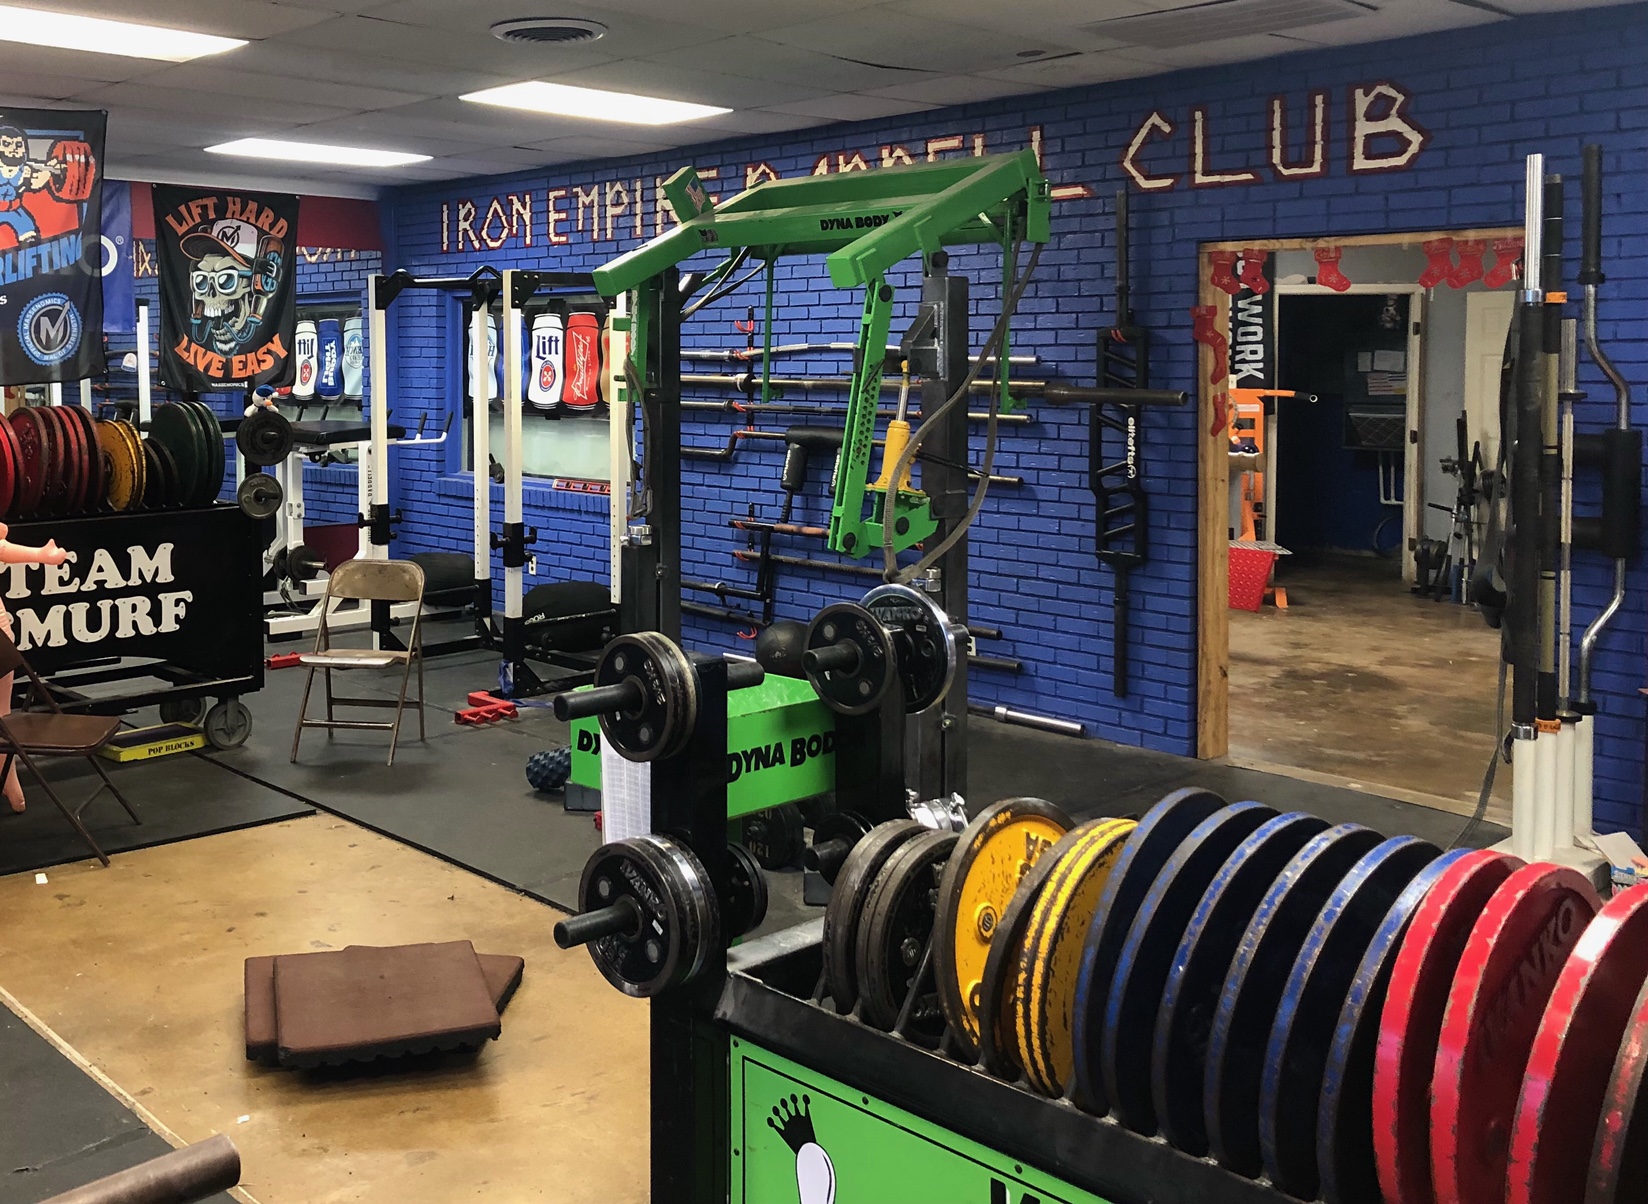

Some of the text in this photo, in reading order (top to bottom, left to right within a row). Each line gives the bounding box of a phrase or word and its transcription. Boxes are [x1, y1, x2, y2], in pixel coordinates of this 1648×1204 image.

[441, 193, 533, 253] IRON
[547, 167, 719, 248] EMPIR
[1119, 81, 1433, 193] CLUB
[165, 196, 289, 239] LIFT HARD
[820, 217, 853, 231] DYNA
[174, 333, 289, 379] LIVE EASY
[536, 335, 560, 360] Lift
[1234, 294, 1265, 381] WORK
[0, 542, 175, 599] TEAM
[147, 743, 164, 756] POP
[727, 731, 837, 784] DYNA BOD
